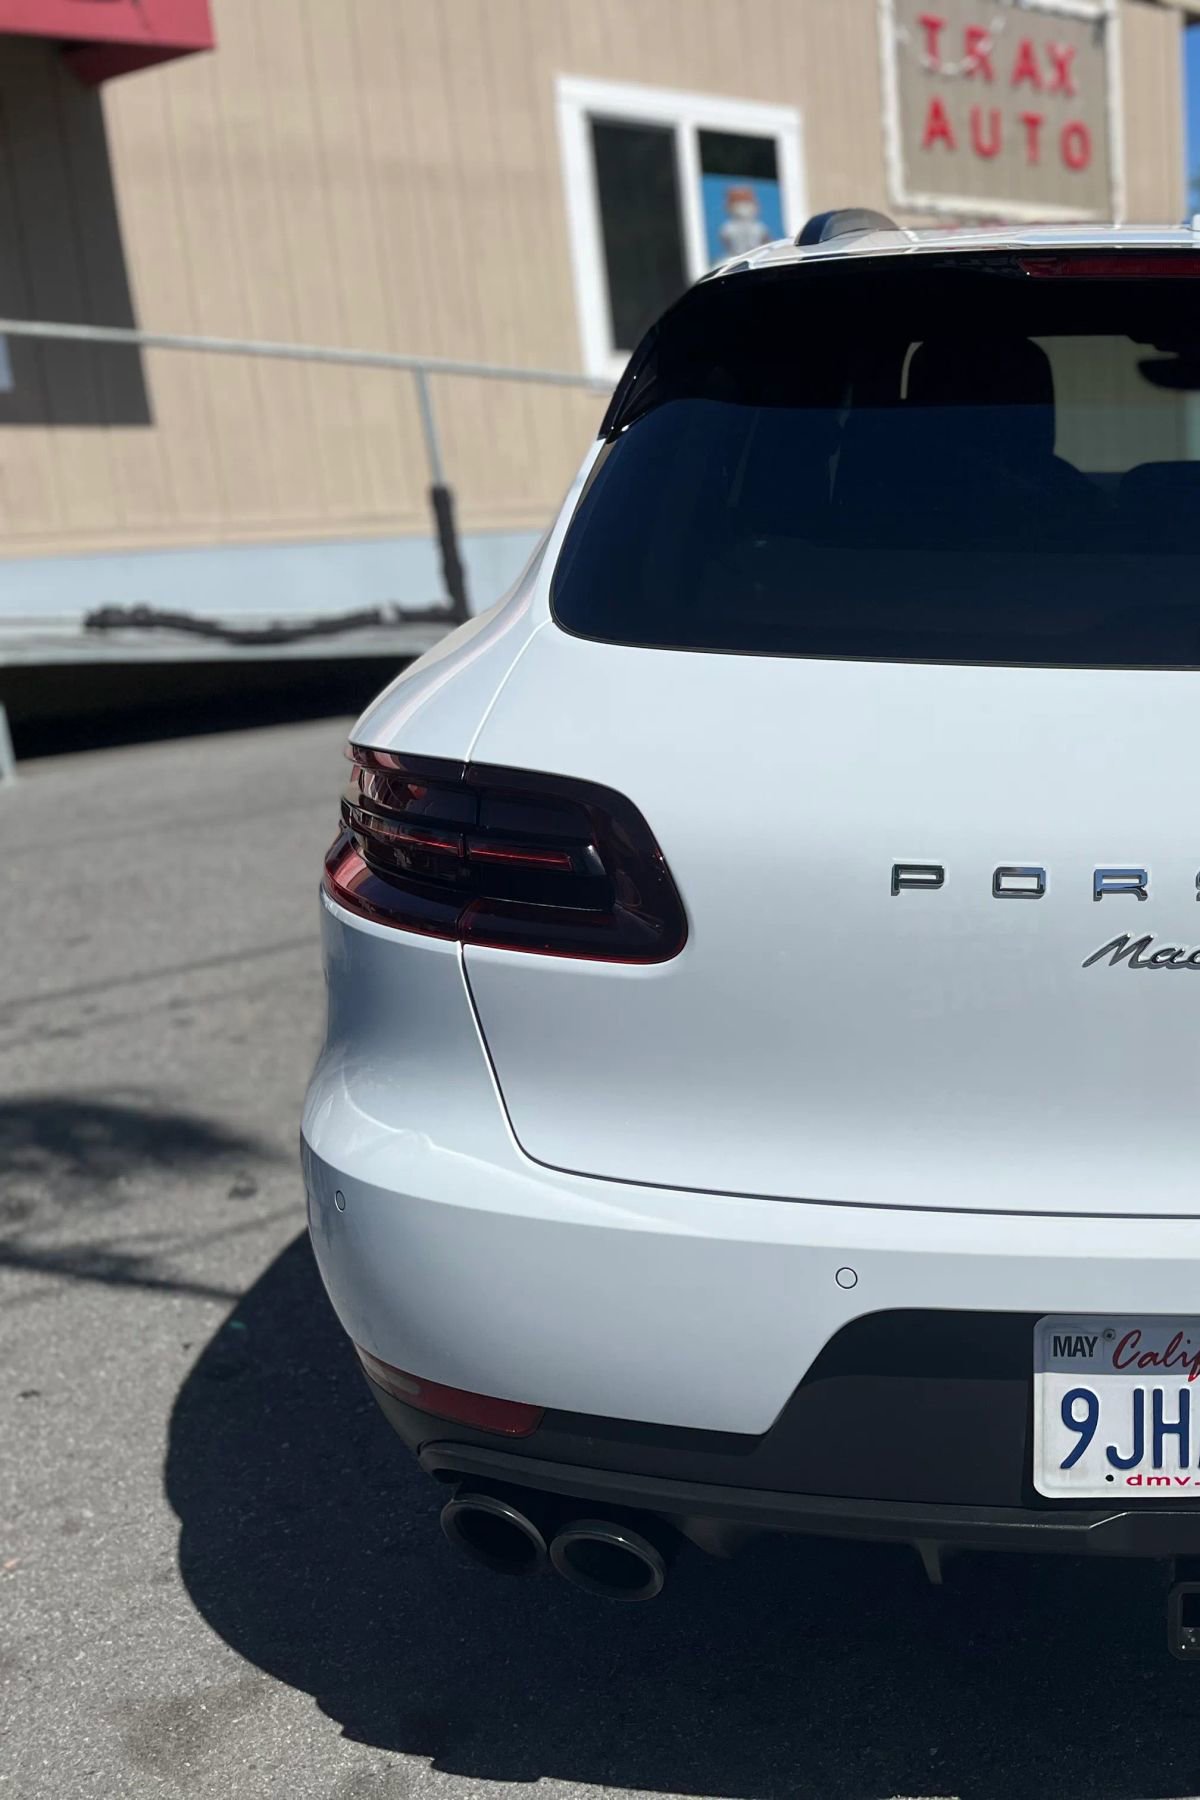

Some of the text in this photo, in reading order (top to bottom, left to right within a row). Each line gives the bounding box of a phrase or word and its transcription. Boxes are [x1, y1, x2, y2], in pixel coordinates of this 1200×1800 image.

[919, 14, 1076, 97] TRAX
[922, 95, 1092, 171] AUTO
[1052, 1335, 1098, 1358] MAY
